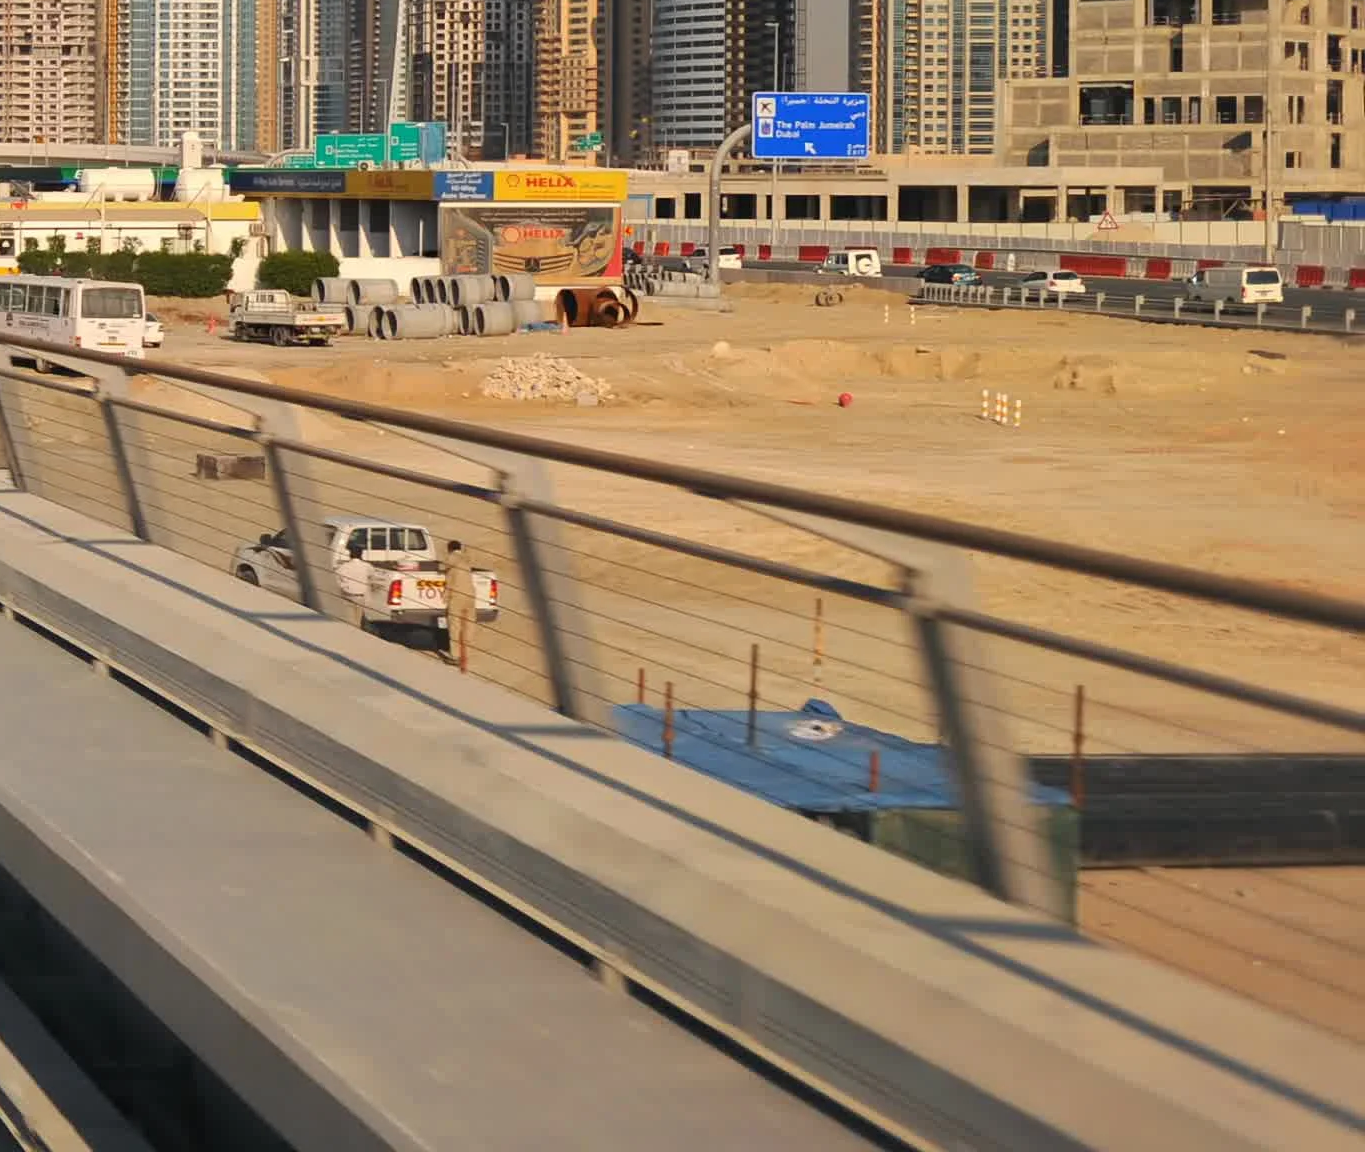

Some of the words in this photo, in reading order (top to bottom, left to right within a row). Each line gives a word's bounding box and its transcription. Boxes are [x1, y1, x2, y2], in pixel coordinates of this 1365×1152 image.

[776, 120, 792, 129] The
[795, 120, 816, 129] Palm
[819, 121, 855, 129] Jumeirah
[776, 129, 801, 138] Dubai
[525, 177, 575, 188] HELIX
[522, 228, 566, 239] HELIX
